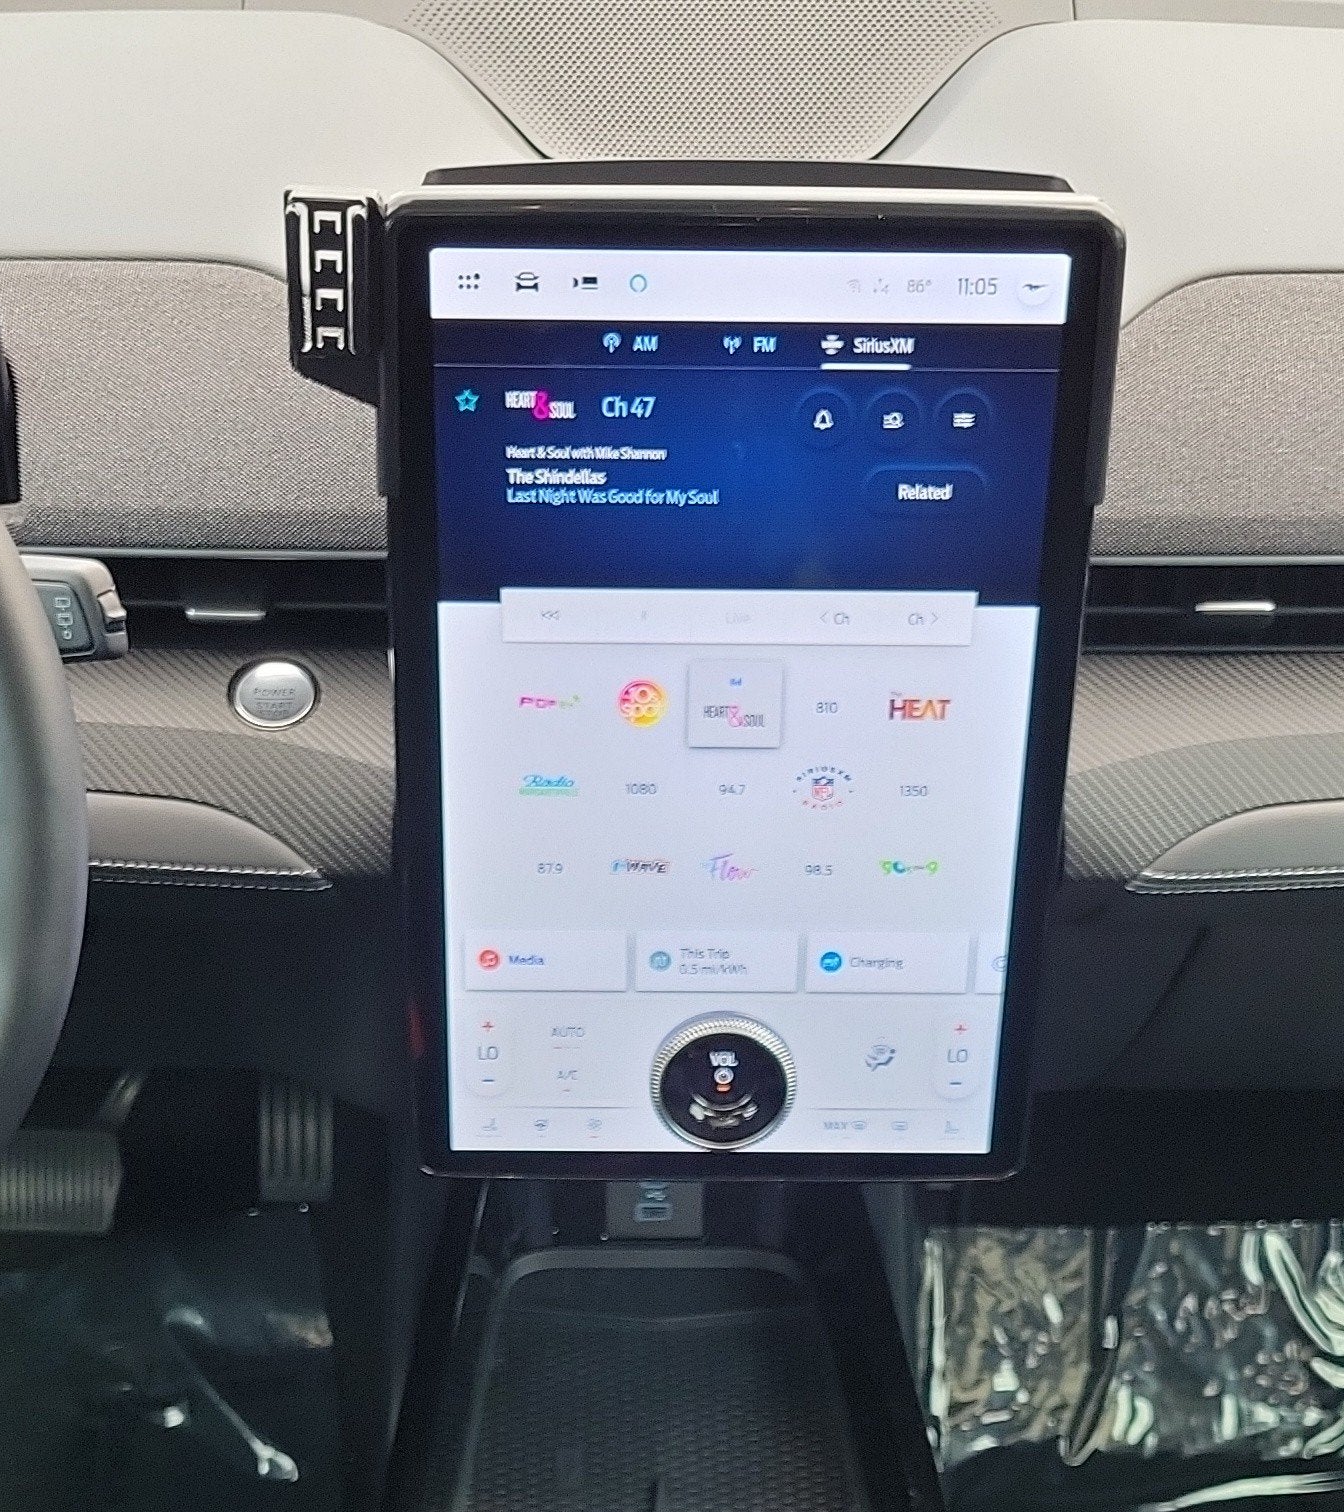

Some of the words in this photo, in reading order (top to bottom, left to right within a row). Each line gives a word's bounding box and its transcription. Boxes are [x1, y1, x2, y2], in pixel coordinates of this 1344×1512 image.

[958, 277, 999, 296] 11:05
[633, 335, 659, 352] AM
[752, 336, 777, 353] FM
[852, 337, 916, 354] SiriusXM
[505, 390, 538, 408] HEART
[549, 401, 577, 419] SOUL
[601, 396, 628, 418] Ch
[630, 396, 656, 418] 47
[506, 445, 536, 459] Heart
[537, 446, 547, 459] &
[547, 446, 570, 460] Soul
[571, 446, 594, 460] with
[594, 447, 620, 460] Mike
[620, 448, 668, 461] Shannon
[506, 468, 535, 484] The
[535, 468, 607, 485] Shindellas
[507, 488, 538, 504] Last
[538, 488, 577, 506] Night
[578, 489, 607, 504] Was
[608, 489, 644, 505] Good
[645, 489, 666, 505] for
[666, 490, 688, 507] My
[688, 489, 720, 505] Soul
[897, 483, 954, 500] Related
[887, 698, 951, 721] HEAT
[899, 785, 929, 797] 1350
[508, 955, 545, 966] Media
[679, 948, 704, 960] This
[707, 948, 730, 960] Trip
[850, 957, 905, 970] Charging
[551, 1026, 586, 1039] AUTO
[477, 1046, 499, 1060] LO
[709, 1051, 739, 1067] VOL
[947, 1048, 969, 1063] LO
